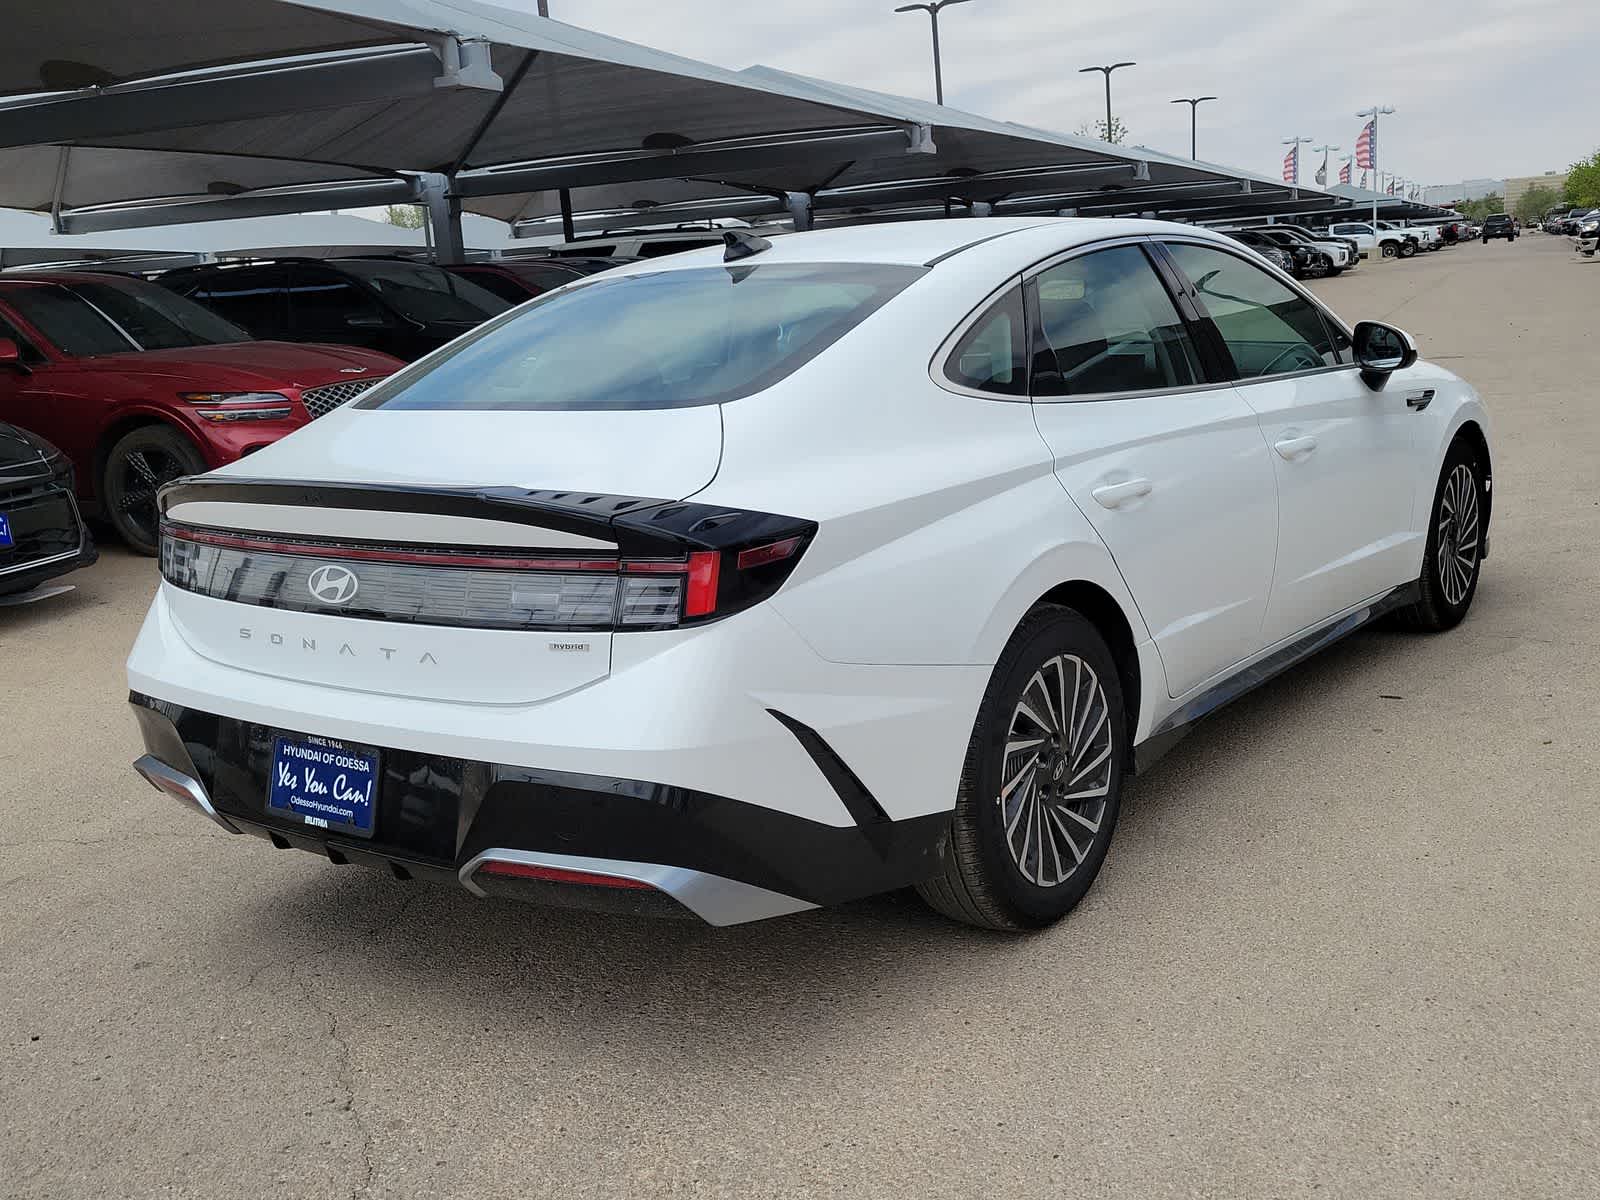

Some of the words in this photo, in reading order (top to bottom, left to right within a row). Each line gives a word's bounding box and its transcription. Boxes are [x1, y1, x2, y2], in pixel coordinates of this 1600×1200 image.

[239, 628, 438, 665] SONATA
[307, 736, 326, 746] SINCE
[327, 739, 343, 749] 1946
[283, 745, 322, 762] HYUNDAI
[322, 753, 335, 765] OF
[335, 755, 370, 773] ODESSA
[278, 761, 297, 790] Yes
[304, 767, 328, 795] You
[333, 774, 372, 807] Can!
[290, 795, 354, 817] OdessaHyundai.com
